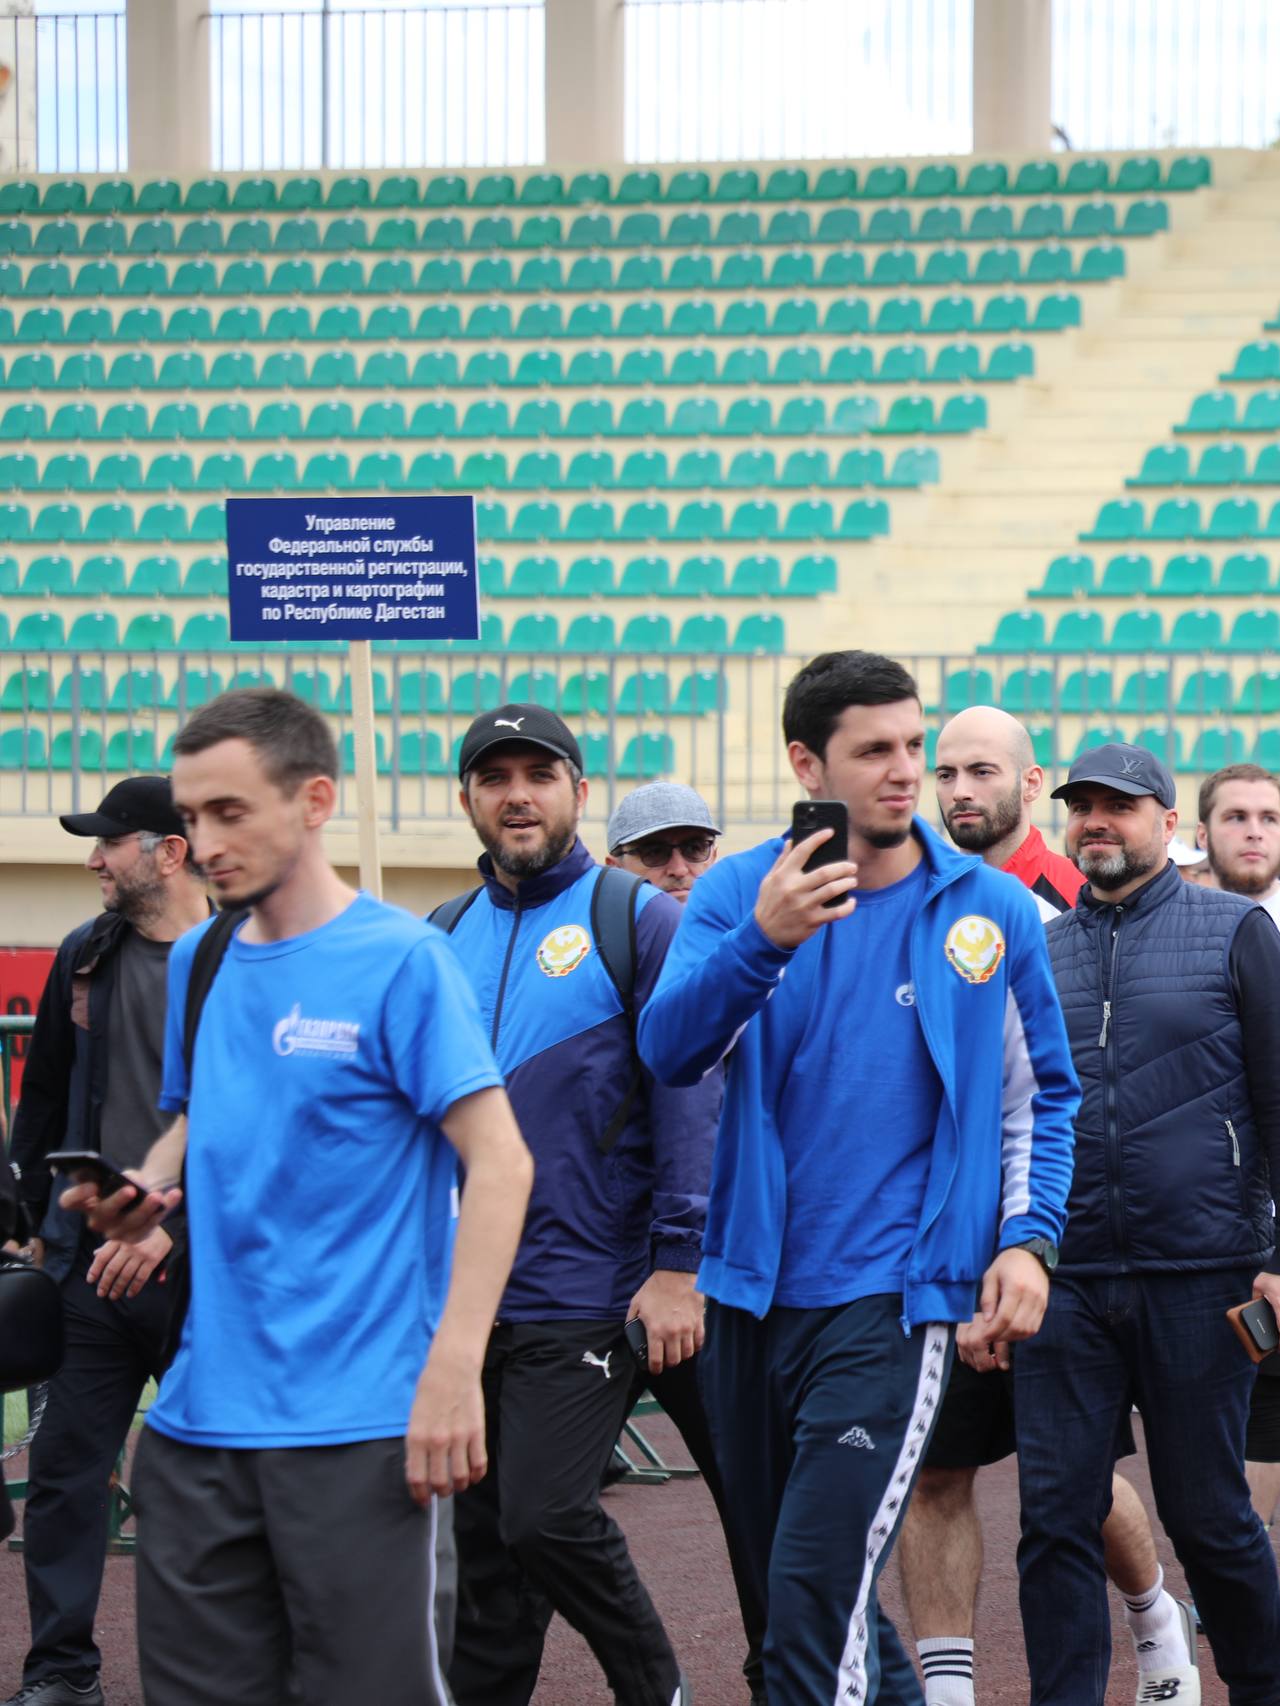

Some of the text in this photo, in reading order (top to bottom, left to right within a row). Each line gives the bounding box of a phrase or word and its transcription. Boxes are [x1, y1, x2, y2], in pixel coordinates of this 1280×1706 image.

[305, 515, 396, 535] Управление
[269, 535, 434, 556] Федеральной службы
[236, 559, 468, 580] государственной регистрации,
[261, 580, 444, 601] кадастра и картографии
[262, 603, 445, 623] по Республике Дагестан
